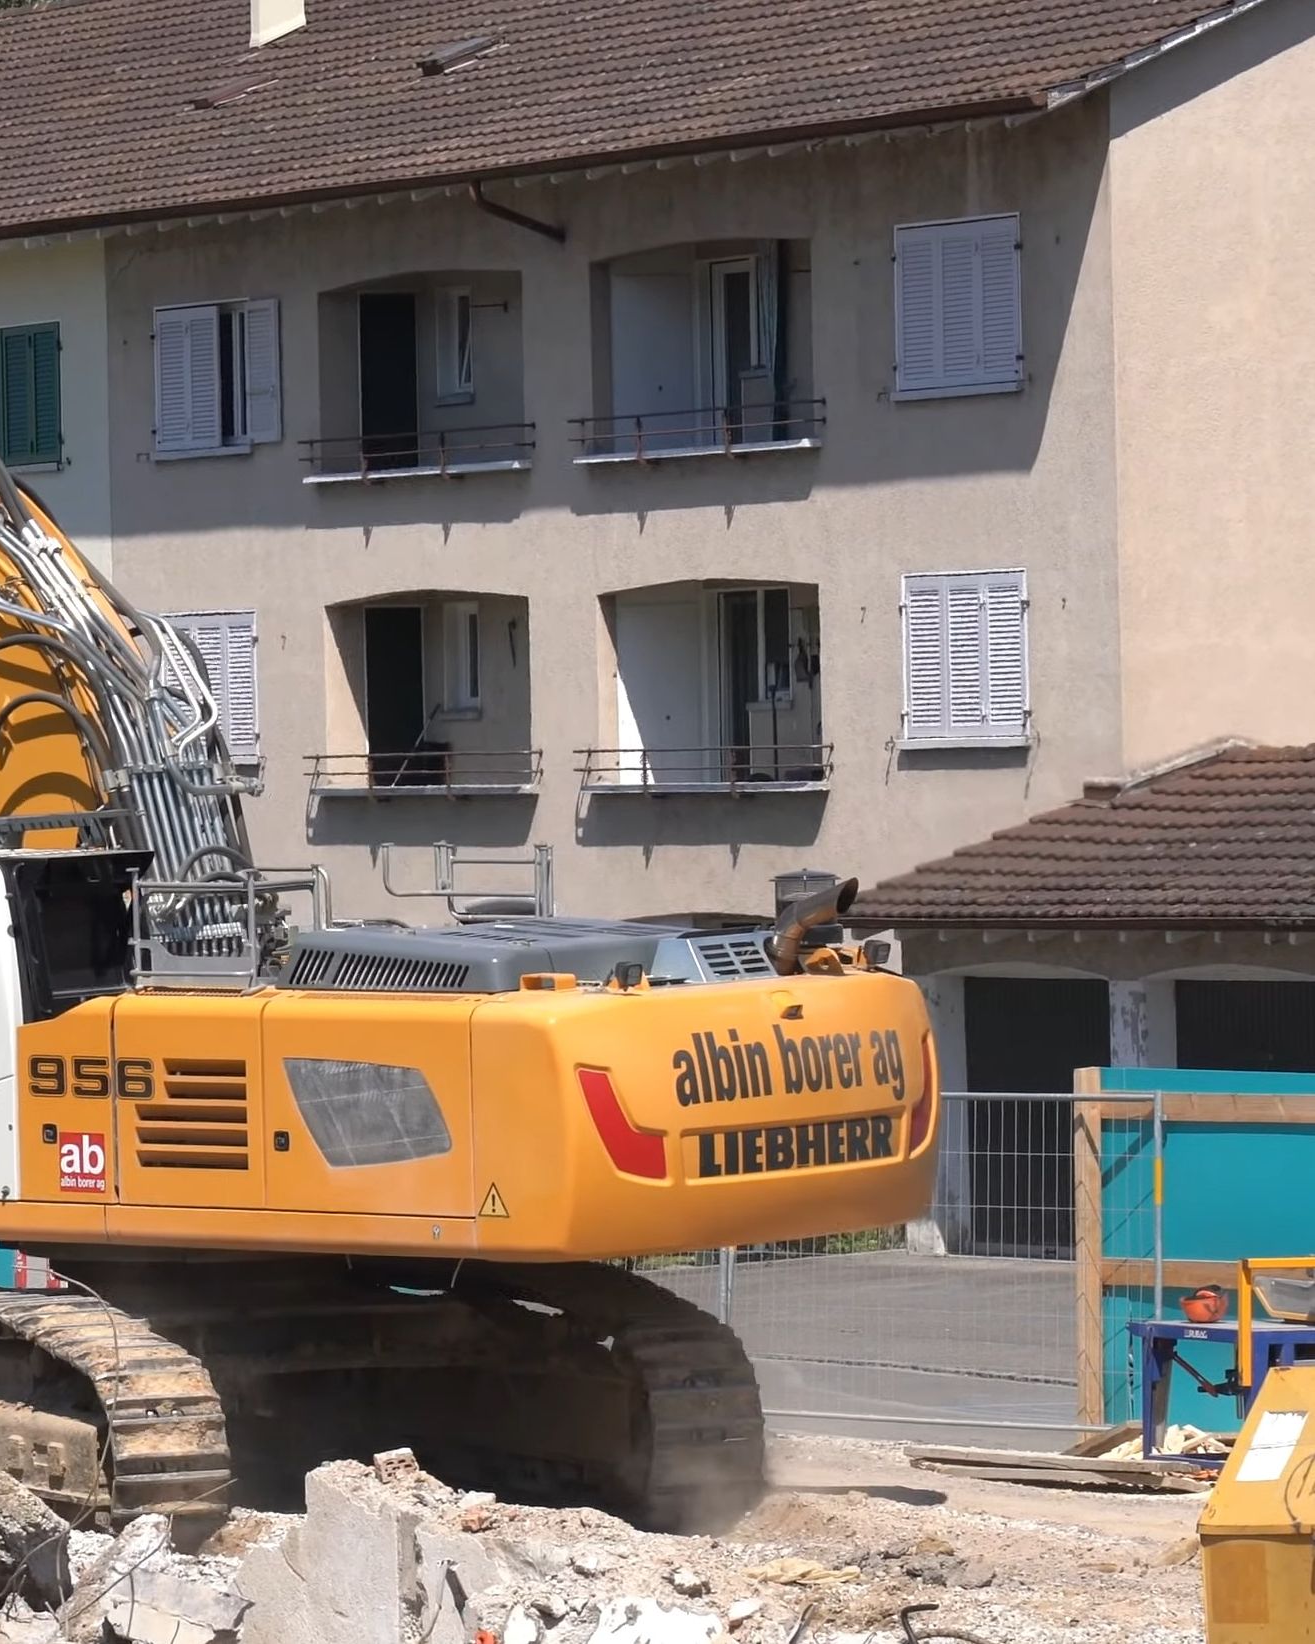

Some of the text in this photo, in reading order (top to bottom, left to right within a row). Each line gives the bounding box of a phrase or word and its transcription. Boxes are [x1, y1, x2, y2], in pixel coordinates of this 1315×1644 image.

[28, 1054, 155, 1101] 956
[673, 1024, 904, 1107] albin borer ag
[60, 1134, 105, 1175] ab
[699, 1115, 893, 1178] LIEBHERR
[60, 1175, 105, 1191] albin borer ag
